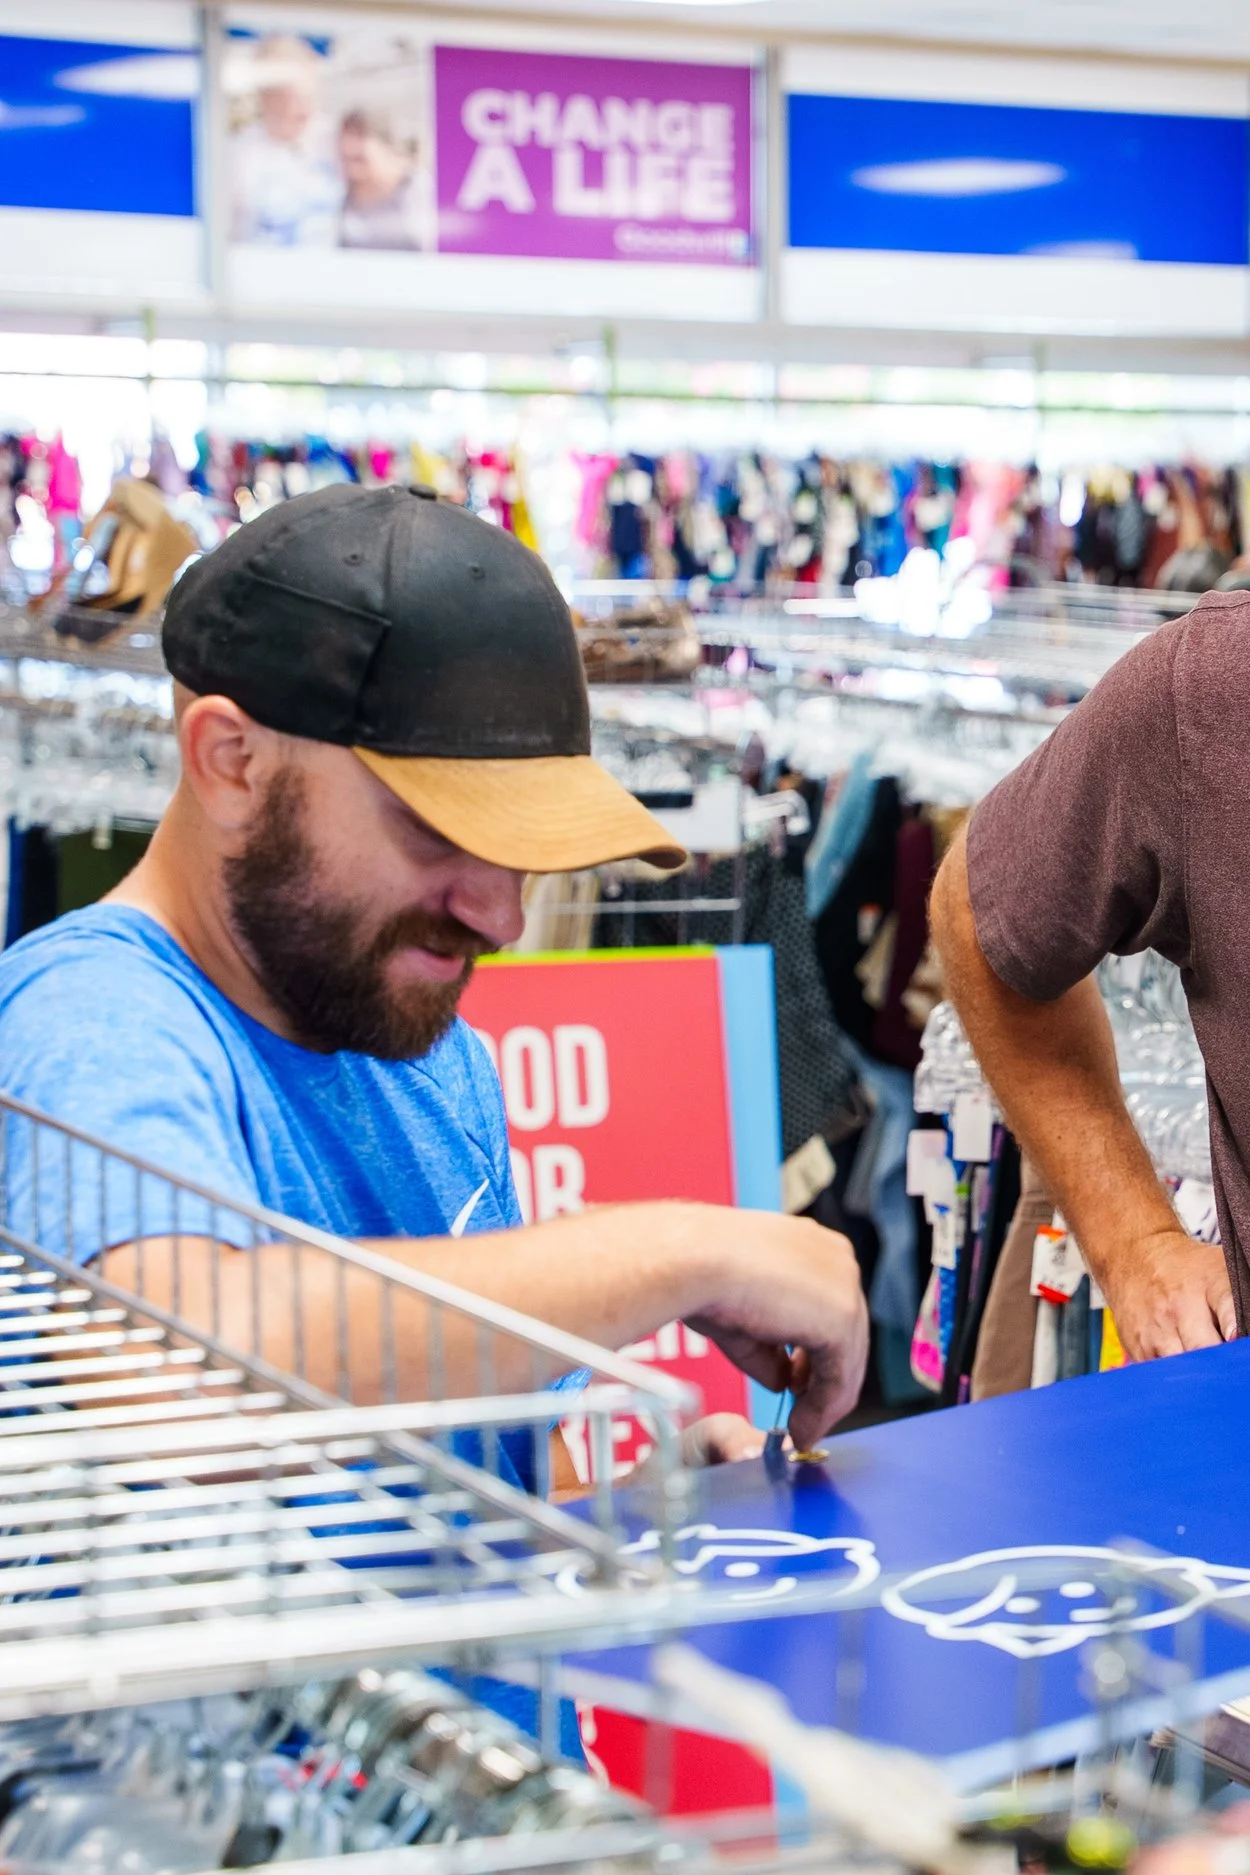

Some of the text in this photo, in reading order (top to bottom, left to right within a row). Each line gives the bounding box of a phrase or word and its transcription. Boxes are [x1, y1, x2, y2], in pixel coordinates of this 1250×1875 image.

[461, 88, 734, 150] CHANGE
[457, 143, 735, 222] A LIFE
